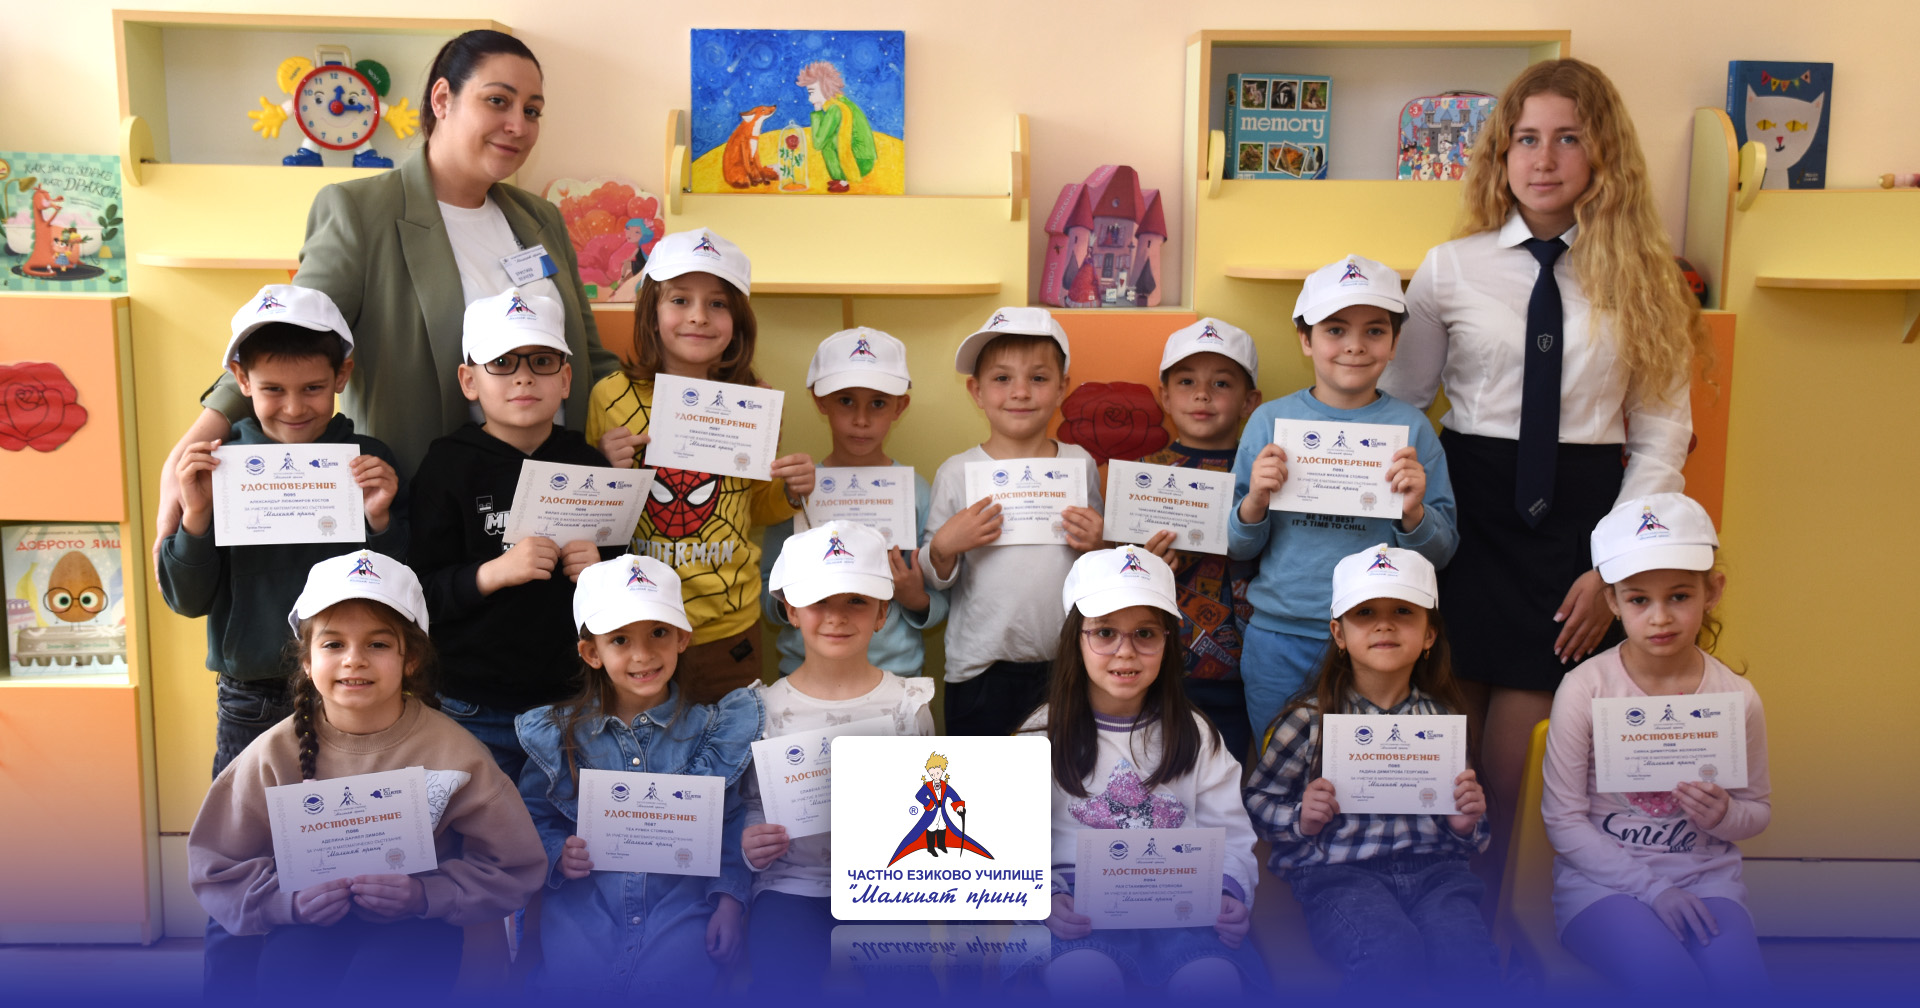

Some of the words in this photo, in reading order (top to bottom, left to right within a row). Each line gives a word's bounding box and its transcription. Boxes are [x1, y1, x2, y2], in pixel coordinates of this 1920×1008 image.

[1434, 100, 1475, 110] PUZZLE
[1240, 116, 1324, 139] memory
[675, 412, 757, 430] УДОСТОВЕРЕНИЕ
[1296, 456, 1382, 468] УДОСТОВЕРЕНИЕ
[241, 482, 337, 492] УДОСТОВЕРЕНИЕ
[540, 495, 624, 506] УДОСТОВЕРЕНИЕ
[1129, 493, 1209, 509] УДОСТОВЕРЕНИЕ
[16, 540, 86, 551] ДОБРОТО
[91, 538, 122, 550] ЯИЦ
[1621, 731, 1718, 742] УДОСТОВЕРЕНИЕ
[1348, 753, 1440, 761] УДОСТОВЕРЕНИЕ
[604, 810, 697, 822] УДОСТОВЕРЕНИЕ
[300, 811, 403, 834] УДОСТОВЕРЕНИЕ
[1602, 812, 1697, 847] Smile
[1102, 867, 1198, 877] УДОСТОВЕРЕНИЕ
